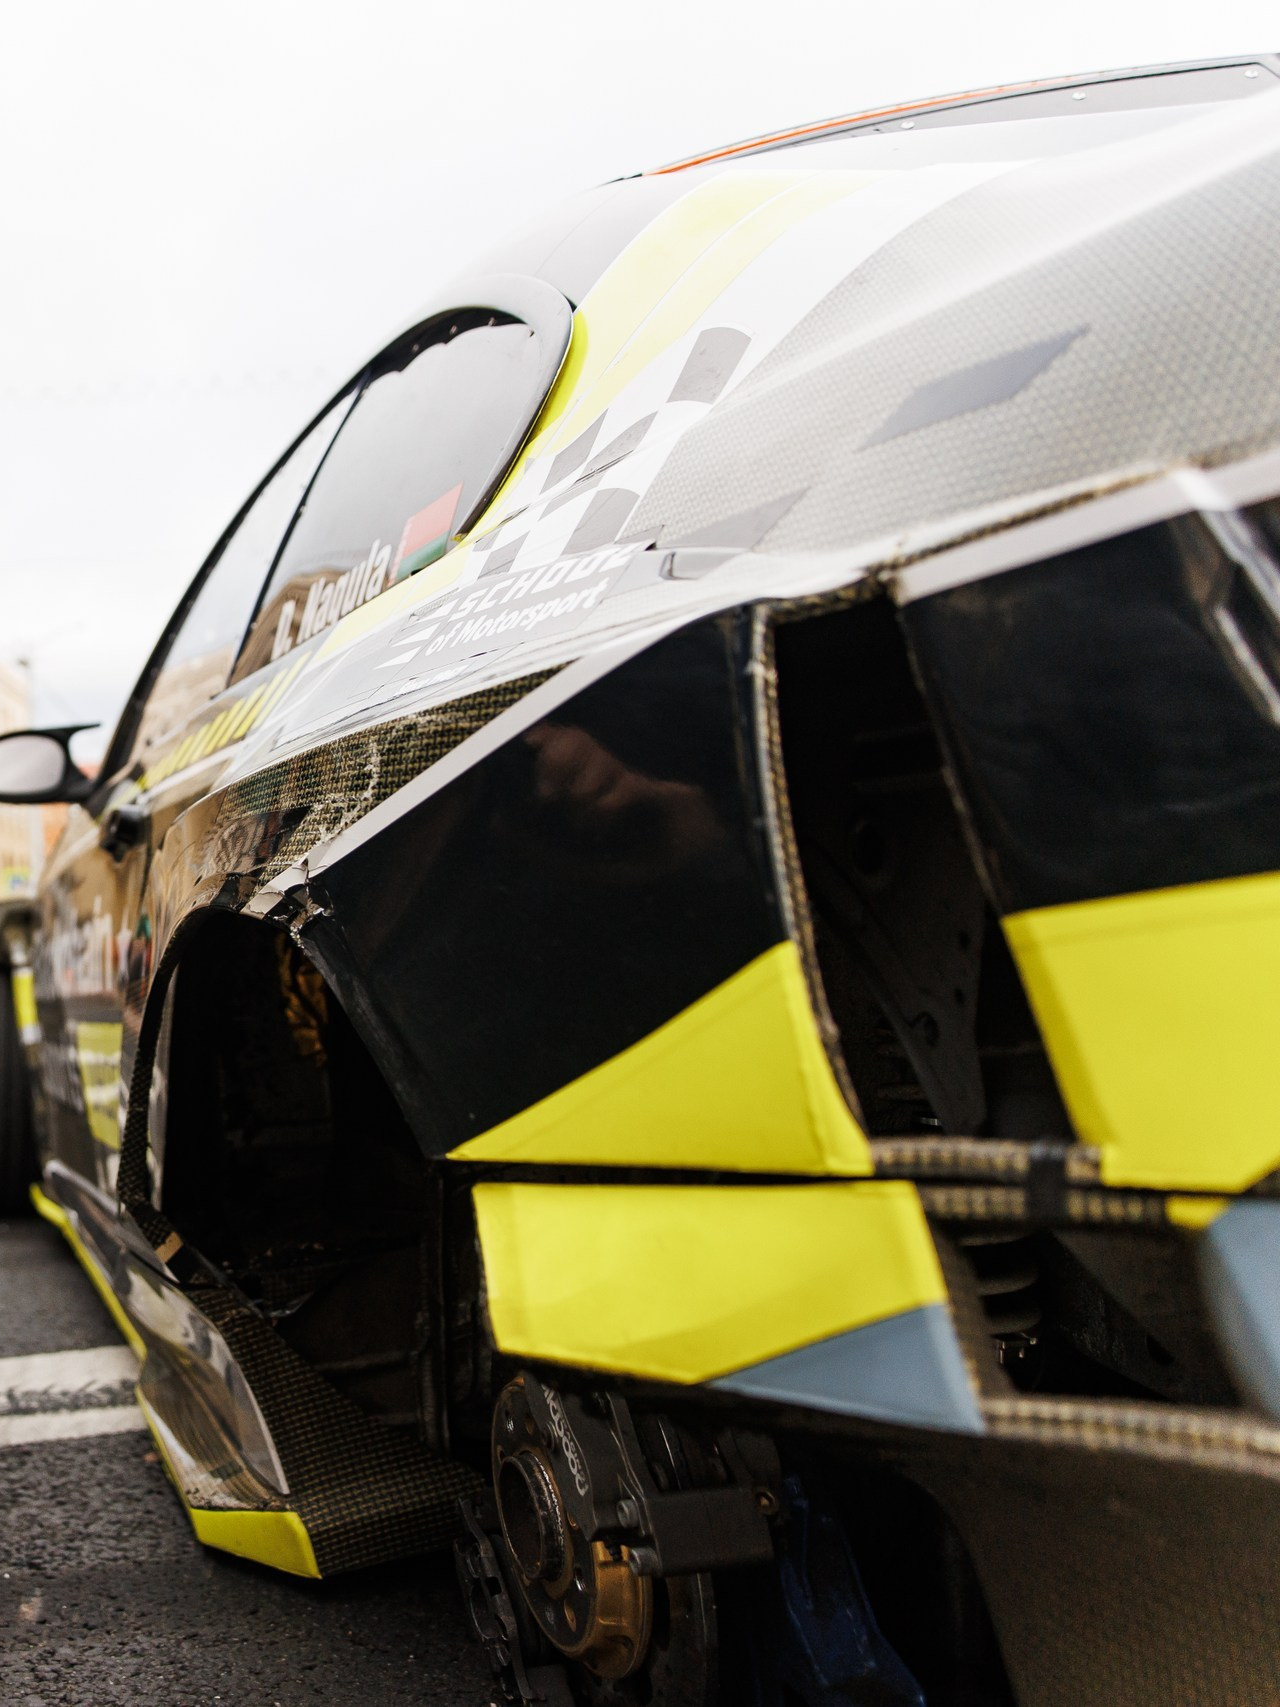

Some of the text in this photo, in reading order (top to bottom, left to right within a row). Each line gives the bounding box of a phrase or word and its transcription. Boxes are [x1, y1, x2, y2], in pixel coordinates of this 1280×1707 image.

[295, 538, 393, 646] Nagula
[424, 577, 609, 657] of Motorsport
[447, 543, 641, 623] SCHOOL
